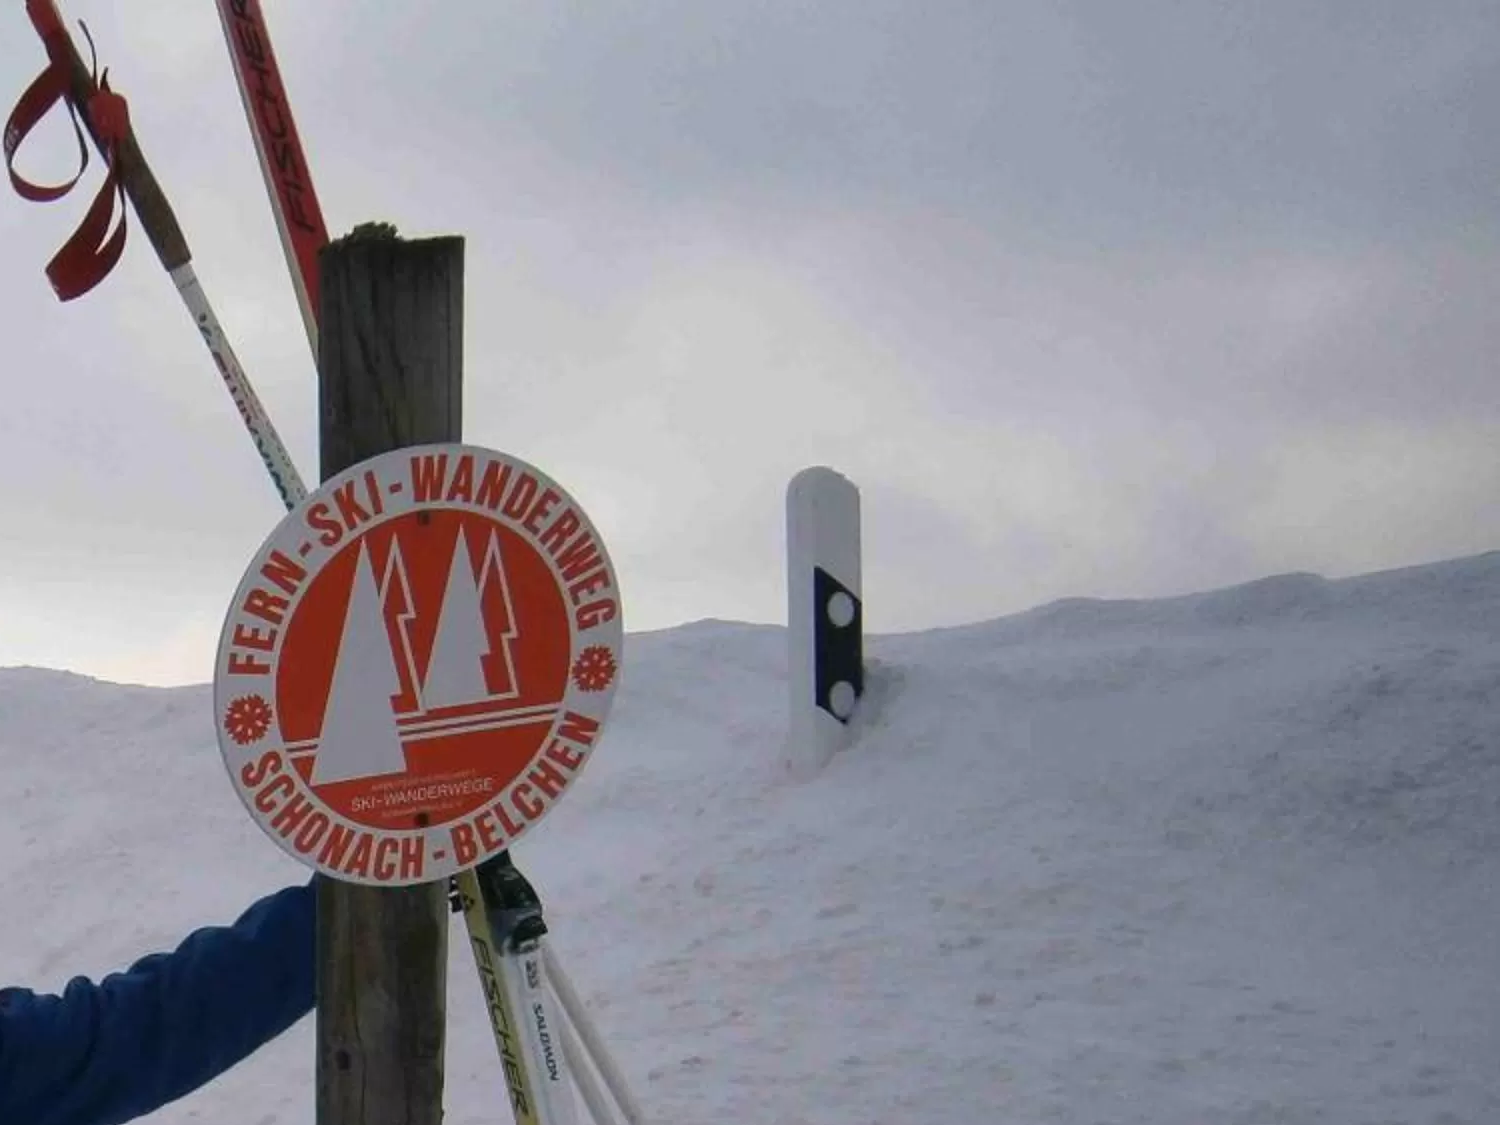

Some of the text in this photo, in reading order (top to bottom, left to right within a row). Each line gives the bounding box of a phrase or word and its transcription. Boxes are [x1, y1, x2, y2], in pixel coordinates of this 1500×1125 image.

[351, 776, 493, 812] SKI-WANDERWEGE
[471, 936, 529, 1117] FISCHER
[532, 1002, 560, 1082] SALOMON
